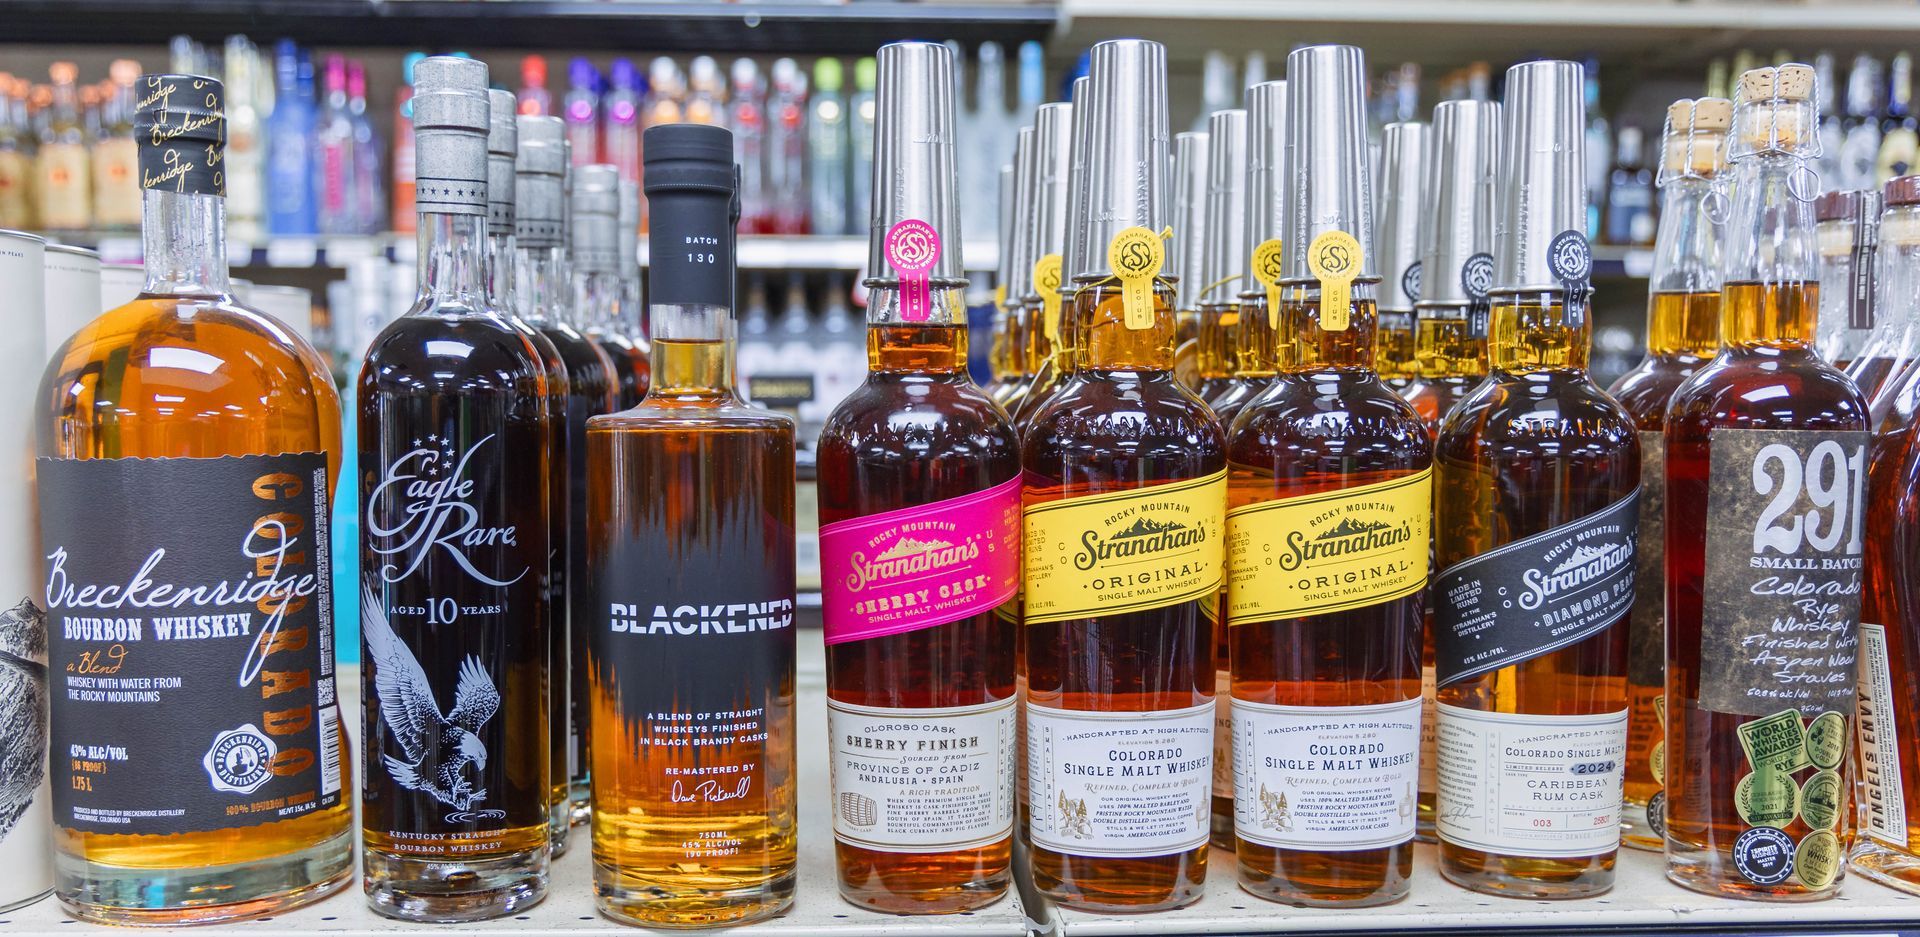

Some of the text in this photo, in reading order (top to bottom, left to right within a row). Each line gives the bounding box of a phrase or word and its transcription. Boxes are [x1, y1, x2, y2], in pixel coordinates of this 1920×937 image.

[685, 236, 718, 245] BATCH
[368, 433, 495, 554] Eagle
[1752, 440, 1864, 555] 291
[1104, 502, 1190, 527] ROCKY MOUNTAIN
[1309, 502, 1395, 527] ROCKY MOUNTAIN
[868, 521, 956, 548] ROCKY MOUNTAIN
[382, 502, 529, 586] Rare
[1074, 520, 1206, 571] Stranahan's
[1279, 520, 1411, 571] Stranahan's
[1544, 525, 1620, 562] ROCKY MOUNTAIN
[846, 534, 979, 592] Stranahan's
[1750, 556, 1862, 570] SMALL BATCH
[1092, 561, 1203, 590] ORIGINAL
[1298, 560, 1408, 590] ORIGINAL
[1518, 536, 1633, 610] Stranahan's
[1097, 577, 1202, 602] SINGLE MALT WHISKEY
[1303, 576, 1407, 602] SINGLE MALT WHISKEY
[1448, 579, 1481, 597] MADE IN
[1750, 572, 1860, 595] Colorado
[855, 574, 987, 615] SHERRY CASK
[1450, 587, 1482, 604] LIMITED
[47, 520, 316, 687] Breckenridge
[391, 597, 501, 624] AGED 10 YEARS
[868, 593, 977, 623] SINGLE MALT WHISKEY
[1468, 607, 1480, 615] THE
[1543, 590, 1609, 627] DIAMOND
[1793, 599, 1840, 620] Rye
[611, 598, 792, 635] BLACKENED
[1452, 611, 1497, 632] STRANAHAN'S
[1551, 617, 1585, 636] SINGLE
[1587, 607, 1609, 622] MALT
[64, 613, 251, 641] BOURBON WHISKEY
[1457, 619, 1495, 637] DISTILLERY
[1771, 616, 1850, 637] Whiskey
[1741, 633, 1831, 649] Finished
[67, 644, 128, 674] a Blend
[1749, 650, 1824, 671] Aspen
[67, 676, 182, 689] WHISKEY WITH WATER FROM
[1772, 670, 1845, 683] Staves
[68, 691, 160, 702] THE ROCKY MOUNTAINS
[658, 713, 692, 721] BLEND
[697, 712, 710, 720] OF
[715, 708, 763, 719] STRAIGHT
[1858, 690, 1876, 745] ENVY
[654, 722, 758, 733] WHISKEYS FINISHED
[864, 724, 956, 734] OLOROSO CASK
[1066, 728, 1138, 741] HANDCRAFTED
[1267, 723, 1339, 735] HANDCRAFTED
[1746, 719, 1795, 740] WORLD
[654, 738, 689, 746] BLACK
[693, 737, 736, 746] BRANDY
[740, 733, 769, 743] CASKS
[847, 735, 979, 751] SHERRY FINISH
[1518, 732, 1590, 744] HANDCRAFTED
[1750, 729, 1799, 749] WHISKIES
[71, 744, 128, 760] 43% ALC/VOL
[216, 735, 268, 763] BRECKENRIDGE
[1109, 748, 1183, 762] COLORADO
[1309, 742, 1385, 756] COLORADO
[1505, 747, 1601, 758] COLORADO SINGLE
[1754, 738, 1801, 758] AWARDS
[665, 763, 755, 775] RE-MASTERED BY
[847, 761, 910, 775] PROVINCE
[940, 762, 980, 774] CADIZ
[1064, 755, 1210, 776] SINGLE MALT WHISKEY
[1265, 752, 1415, 771] SINGLE MALT WHISKEY
[1577, 762, 1612, 773] 2024
[1758, 754, 1788, 769] WORLD'S
[1775, 758, 1795, 771] RYE
[72, 775, 92, 791] 1.75 L
[219, 764, 266, 786] DISTILLERY
[858, 774, 964, 785] ANDALUSIA SPAIN
[1285, 775, 1373, 787] REFINED, COMPLEX
[1527, 778, 1608, 789] CARIBBEAN
[934, 785, 980, 795] TRADITION
[1084, 781, 1172, 794] REFINED, COMPLEX
[1533, 790, 1604, 801] RUM CASK
[1760, 803, 1778, 811] 2021
[1533, 819, 1552, 828] 003
[390, 828, 508, 840] KENTUCKY STRAIGHT
[699, 831, 728, 839] 750ML
[394, 841, 502, 852] BOURBON WHISKEY
[682, 839, 742, 849] 45% ALC/VOL
[1807, 850, 1833, 864] WHISKY
